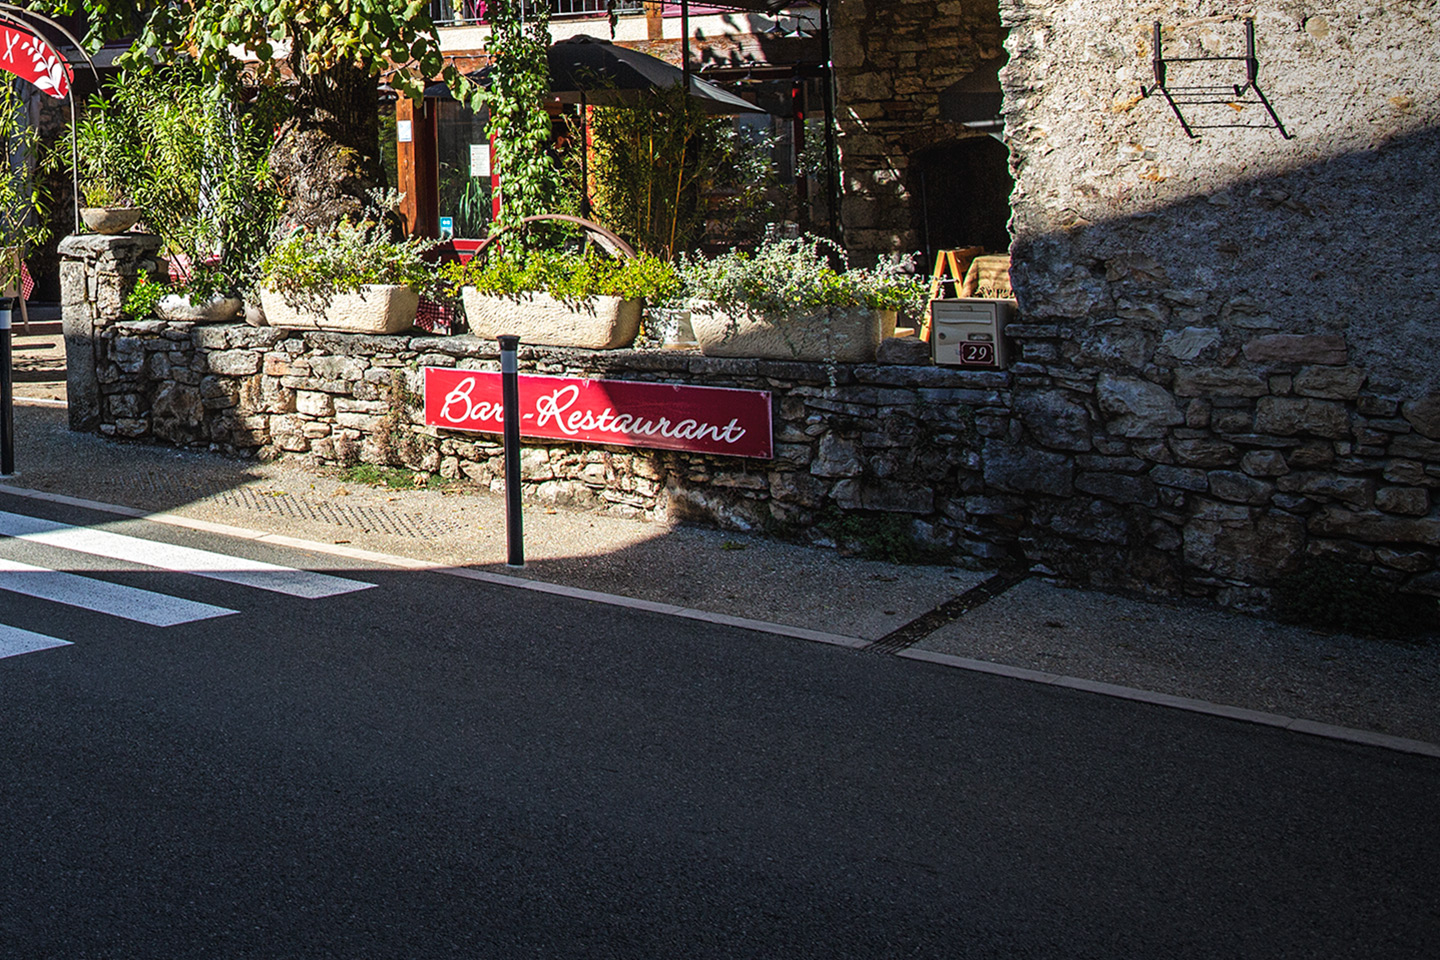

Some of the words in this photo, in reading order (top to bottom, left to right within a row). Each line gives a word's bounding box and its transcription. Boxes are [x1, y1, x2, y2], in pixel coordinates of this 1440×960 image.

[967, 346, 987, 360] 29
[441, 377, 503, 423] Bar
[537, 384, 746, 444] Restaurant
